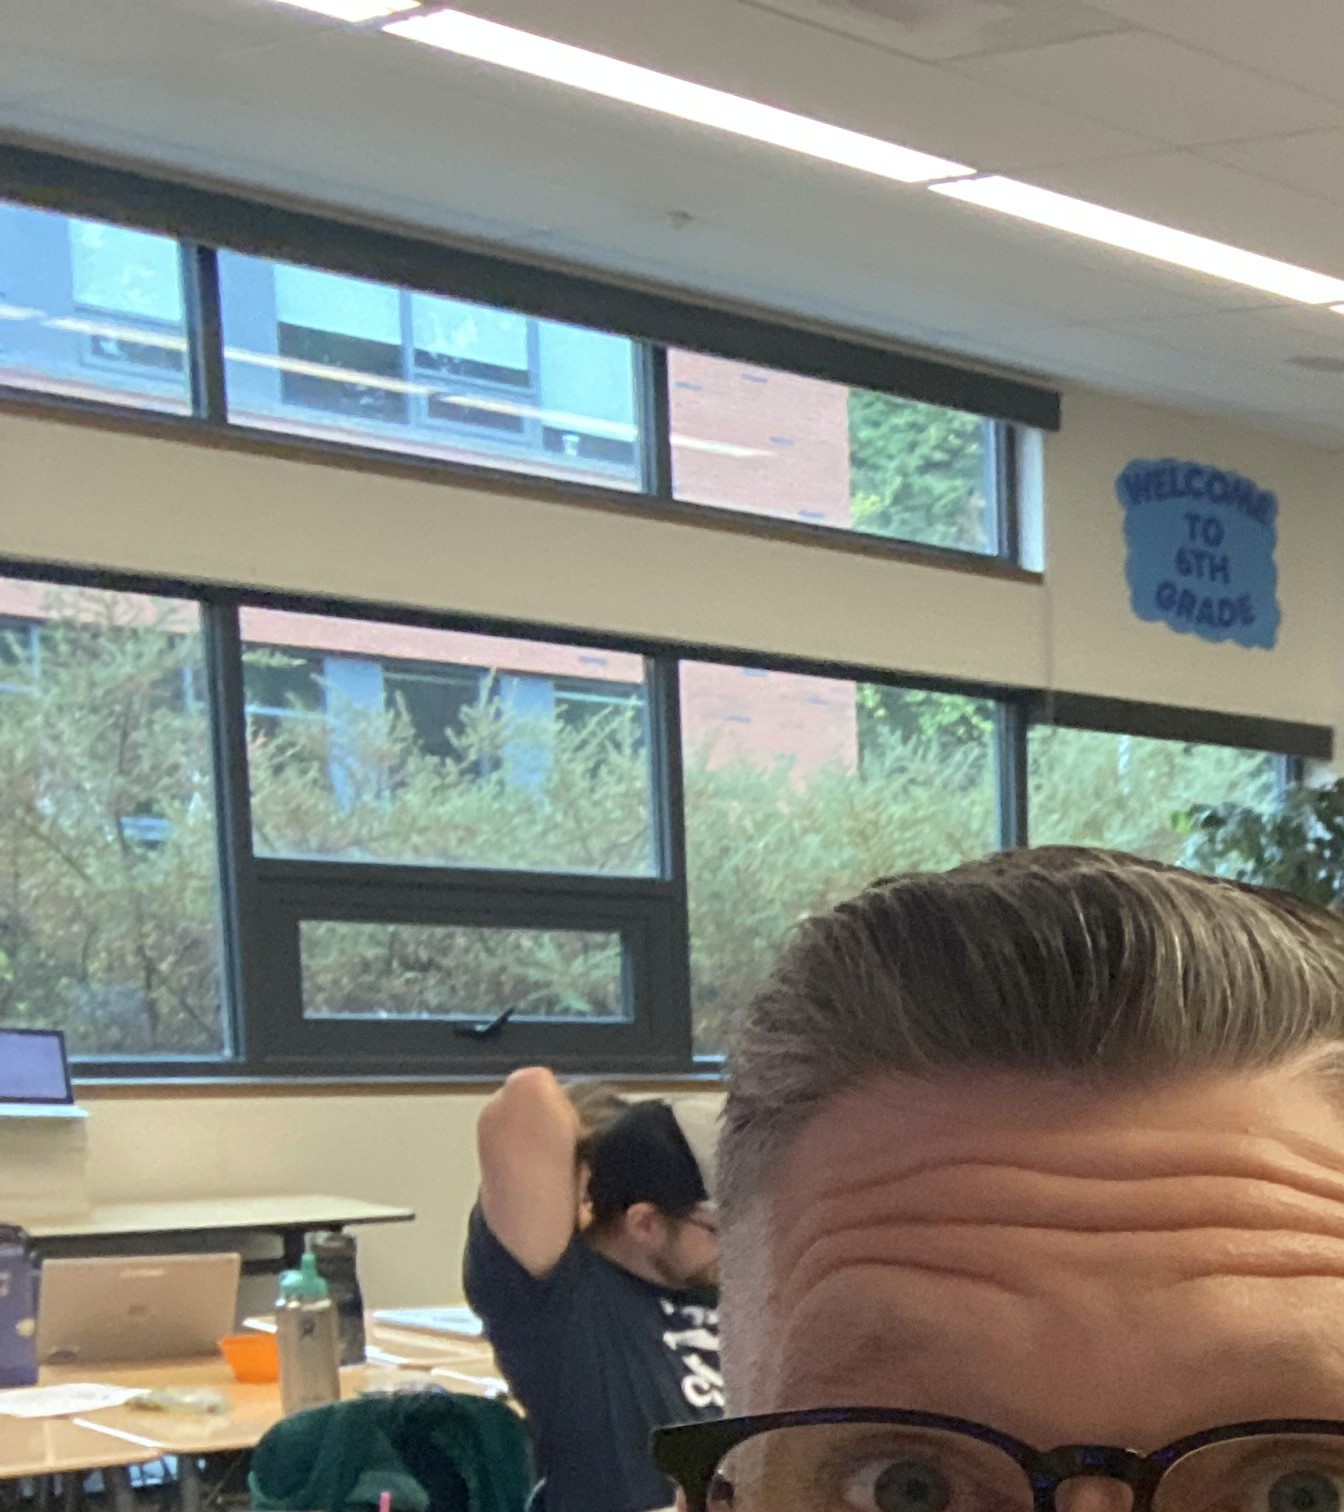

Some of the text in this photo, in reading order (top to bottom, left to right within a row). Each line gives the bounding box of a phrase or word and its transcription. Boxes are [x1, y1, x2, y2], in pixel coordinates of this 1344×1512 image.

[1122, 466, 1275, 523] WELCOME
[1184, 511, 1225, 548] TO
[1174, 547, 1231, 585] 6TH
[1156, 580, 1255, 628] GRADE
